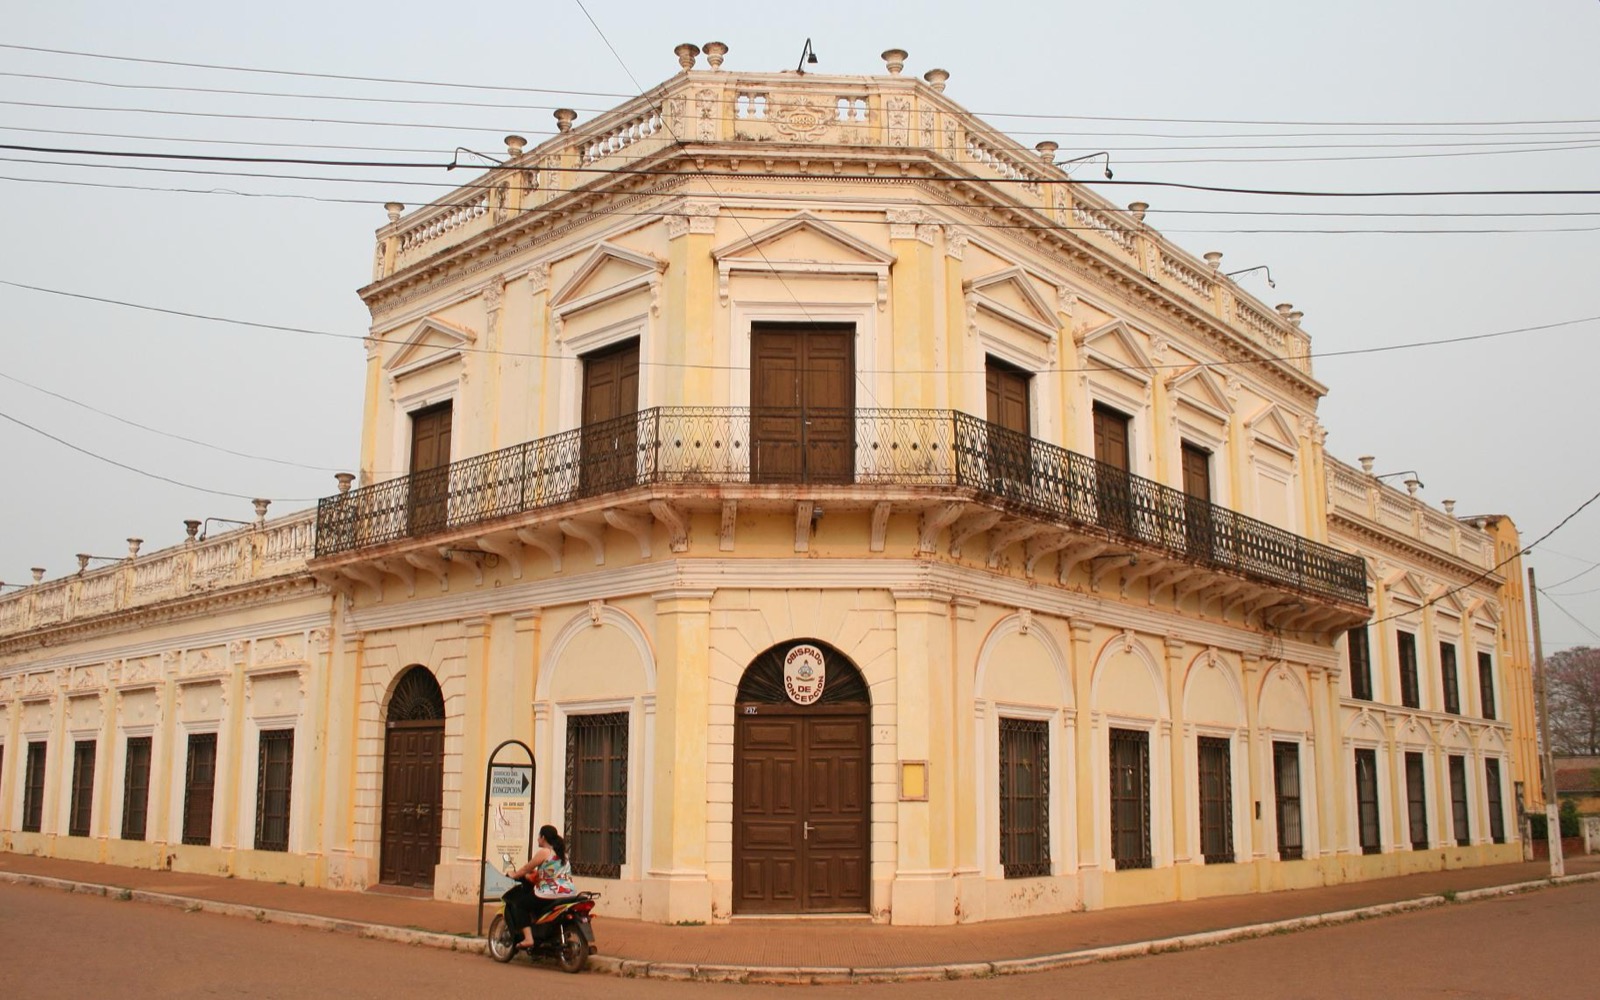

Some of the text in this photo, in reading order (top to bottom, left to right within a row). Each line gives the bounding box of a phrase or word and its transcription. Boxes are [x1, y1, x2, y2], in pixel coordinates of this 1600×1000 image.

[787, 647, 822, 665] OBISPADO
[786, 675, 824, 702] CONCEPCION
[797, 685, 811, 693] DE
